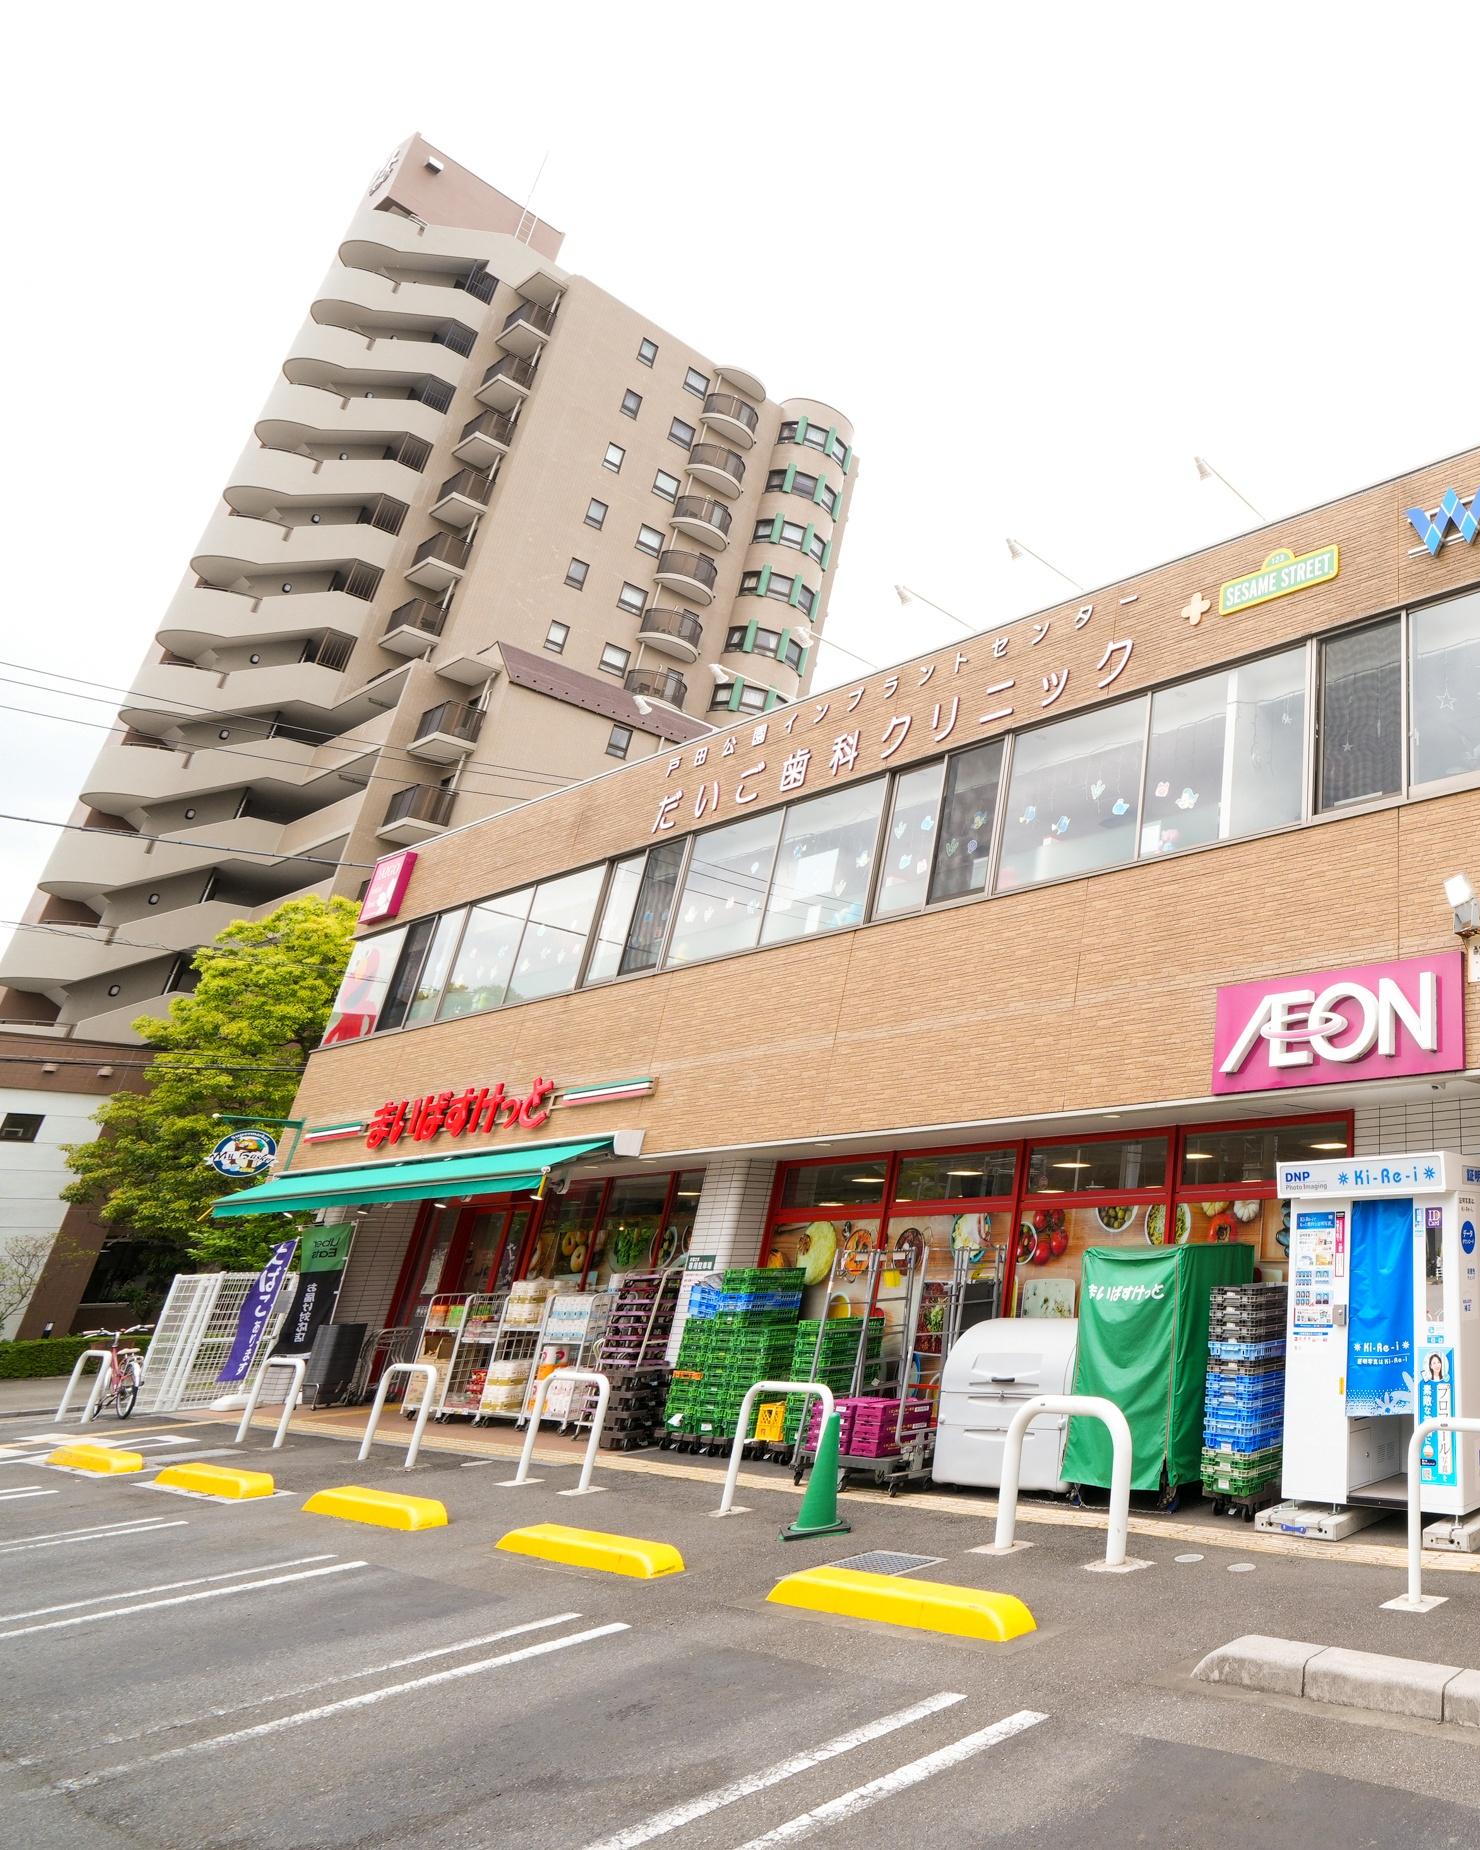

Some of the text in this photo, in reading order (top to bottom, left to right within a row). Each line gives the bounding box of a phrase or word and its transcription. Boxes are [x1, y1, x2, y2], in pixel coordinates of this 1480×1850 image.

[1226, 572, 1277, 607] SESAME
[666, 594, 1139, 778] 戸田公園インプラントセンター
[650, 637, 1134, 835] だいご歯科クリニック
[366, 1076, 555, 1150] まいばすけっと
[1285, 1171, 1311, 1183] DNP
[1354, 1166, 1418, 1185] Ki-Re-i
[1285, 1182, 1328, 1191] Photo Imaging
[1428, 1210, 1440, 1221] ID
[1088, 1283, 1165, 1301] まいばすけっと
[1363, 1341, 1400, 1353] Ki-Re-i
